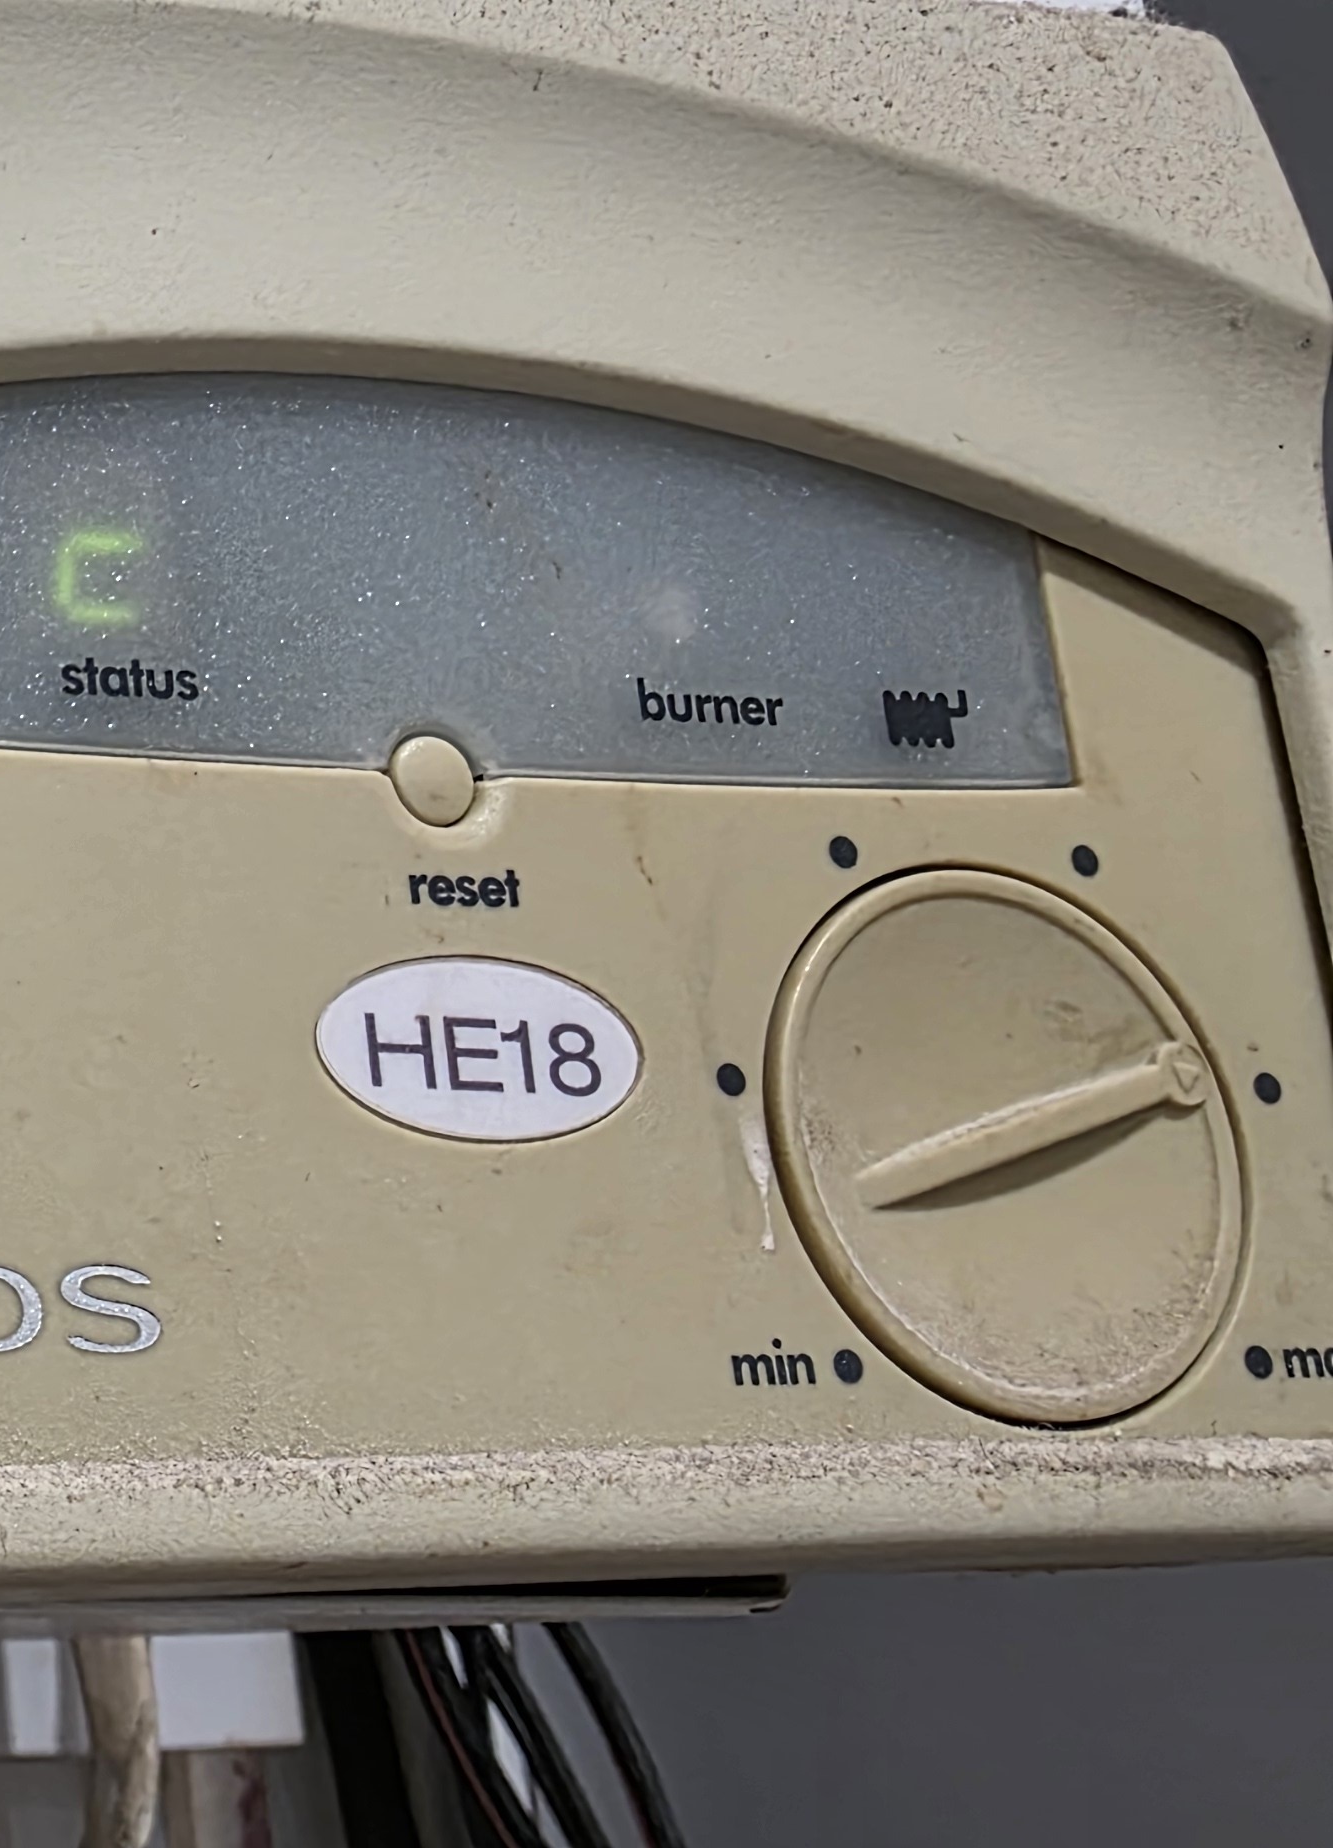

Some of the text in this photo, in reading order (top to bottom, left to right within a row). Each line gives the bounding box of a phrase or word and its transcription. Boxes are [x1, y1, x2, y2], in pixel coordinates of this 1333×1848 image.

[60, 657, 200, 701] status
[636, 677, 784, 727] burner
[407, 868, 521, 909] reset
[363, 1011, 602, 1098] HE18
[731, 1338, 817, 1388] min
